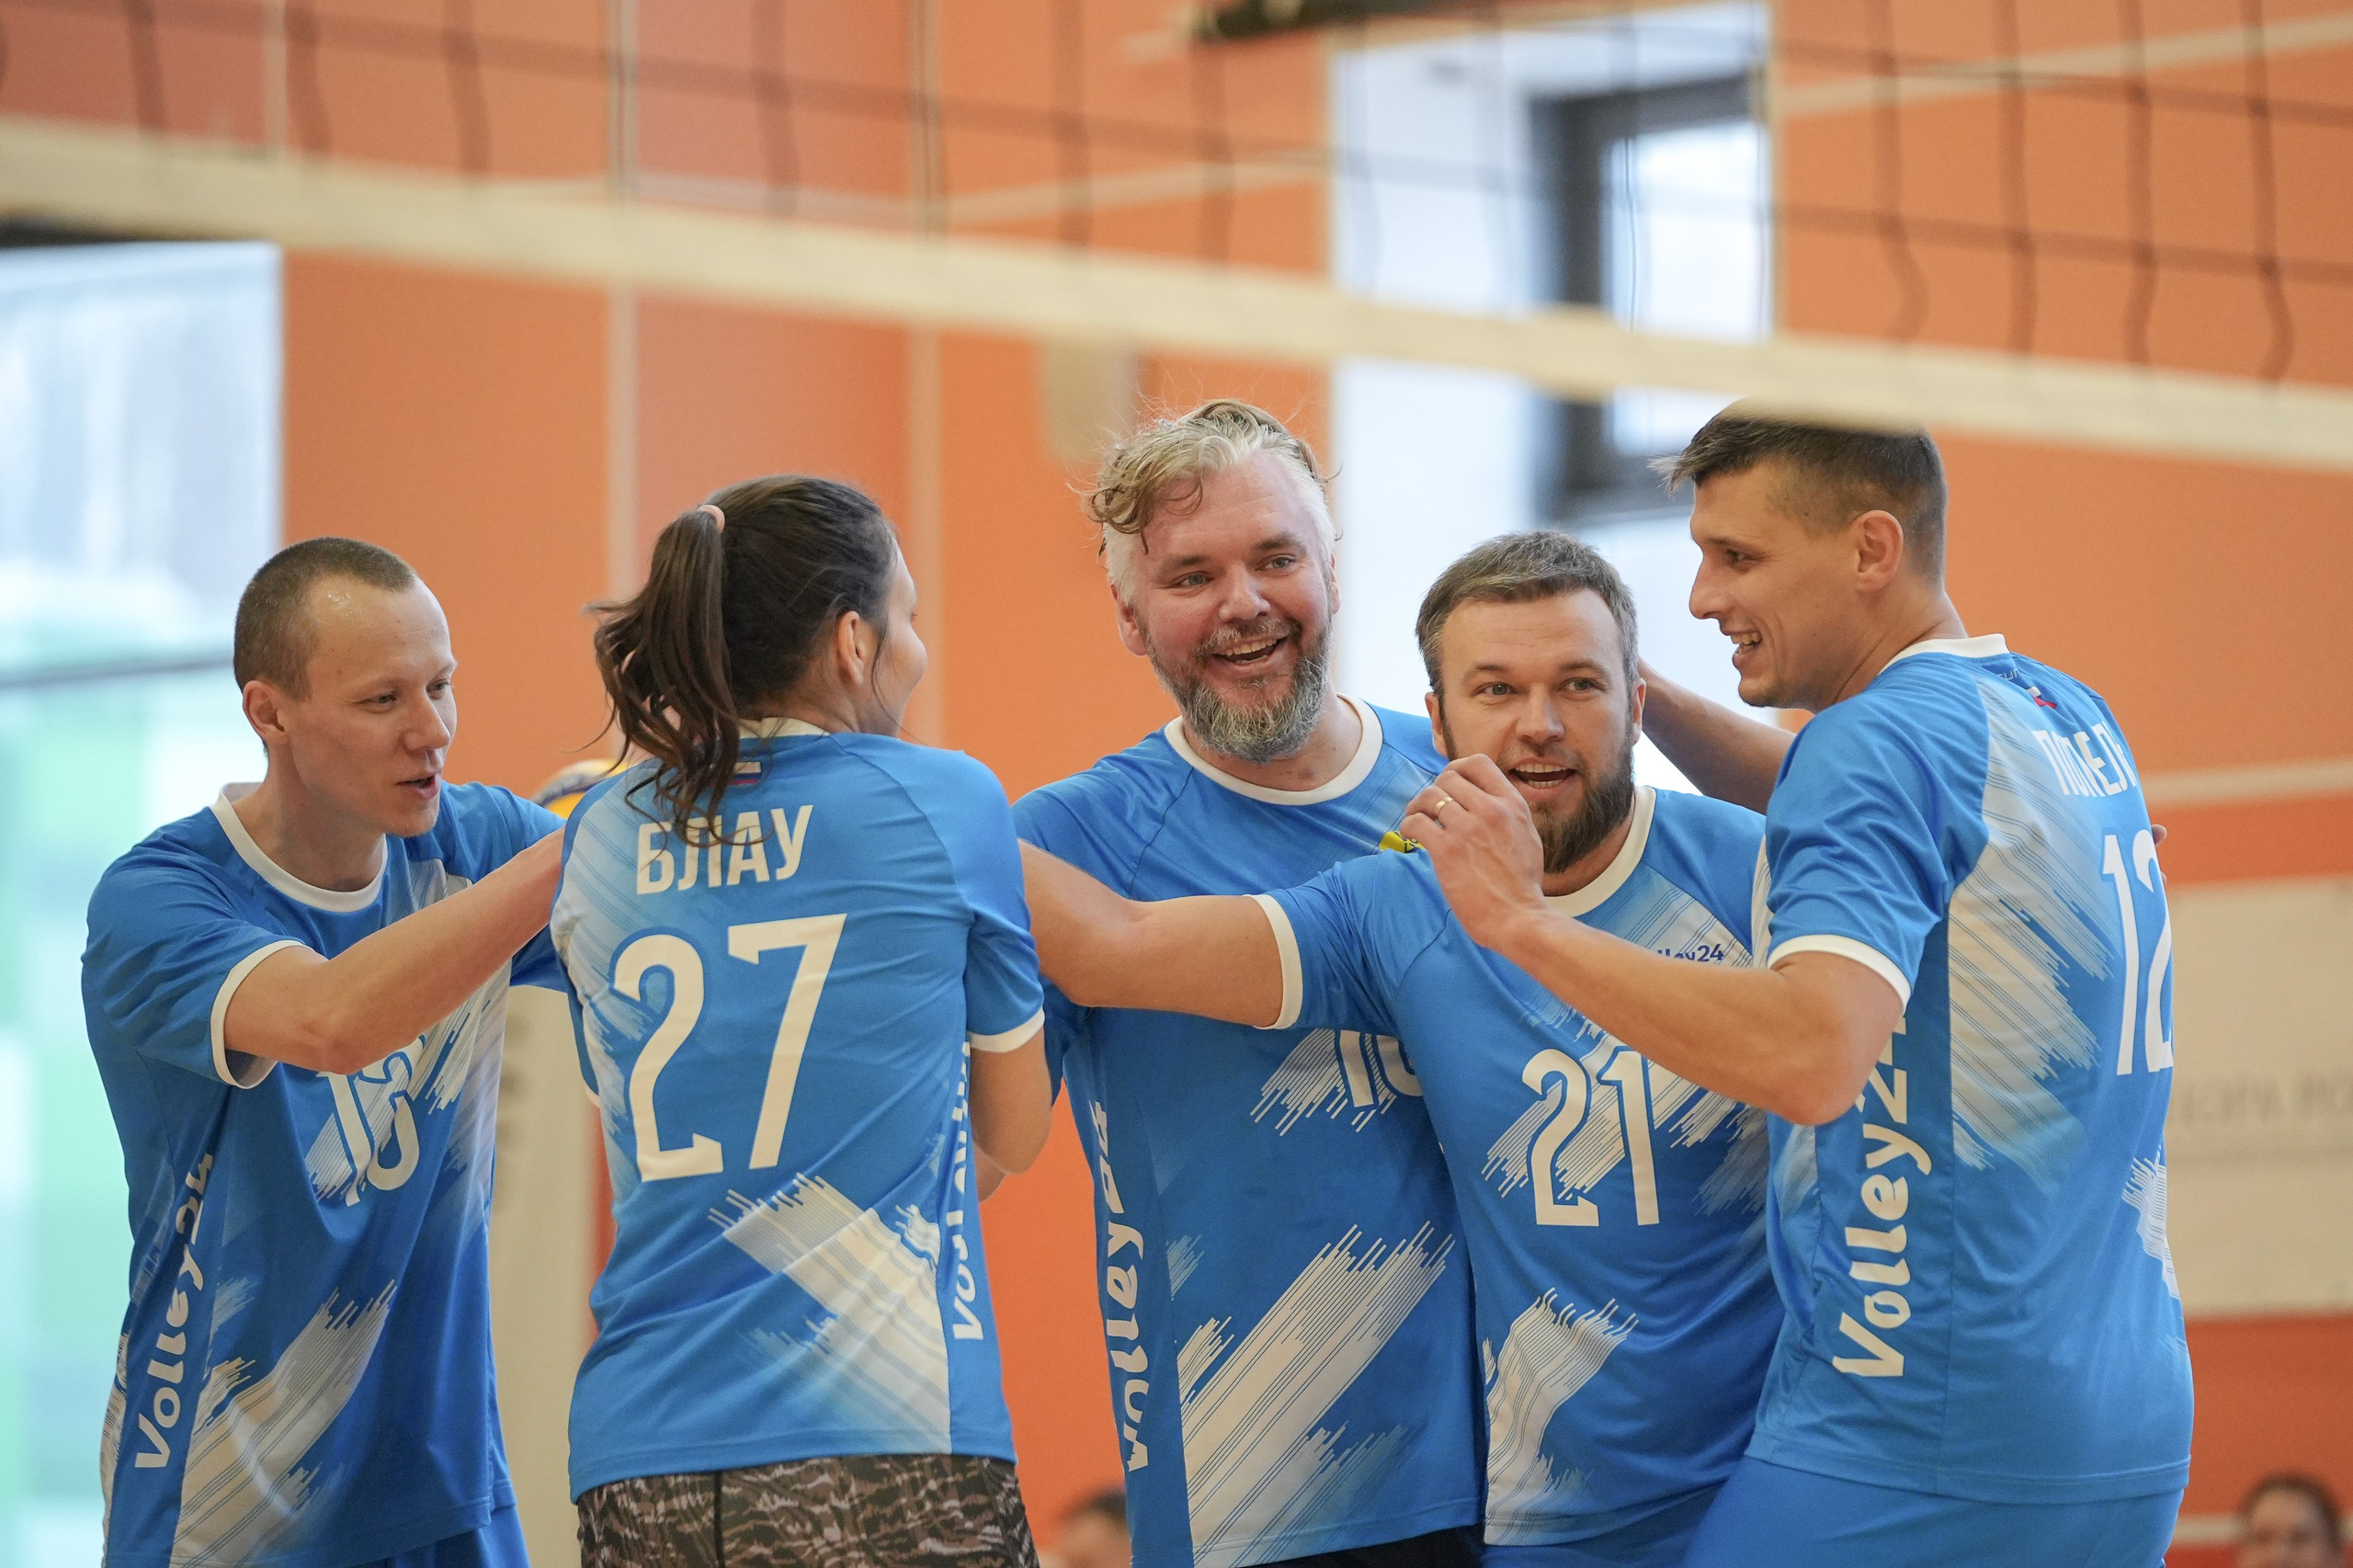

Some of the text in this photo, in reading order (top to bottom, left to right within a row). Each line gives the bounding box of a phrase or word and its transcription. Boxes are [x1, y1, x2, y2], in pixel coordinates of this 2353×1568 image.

[636, 804, 813, 895] БЛАУ
[2102, 829, 2174, 1076] 12
[613, 913, 847, 1182] 27
[1522, 1049, 1660, 1226] 21
